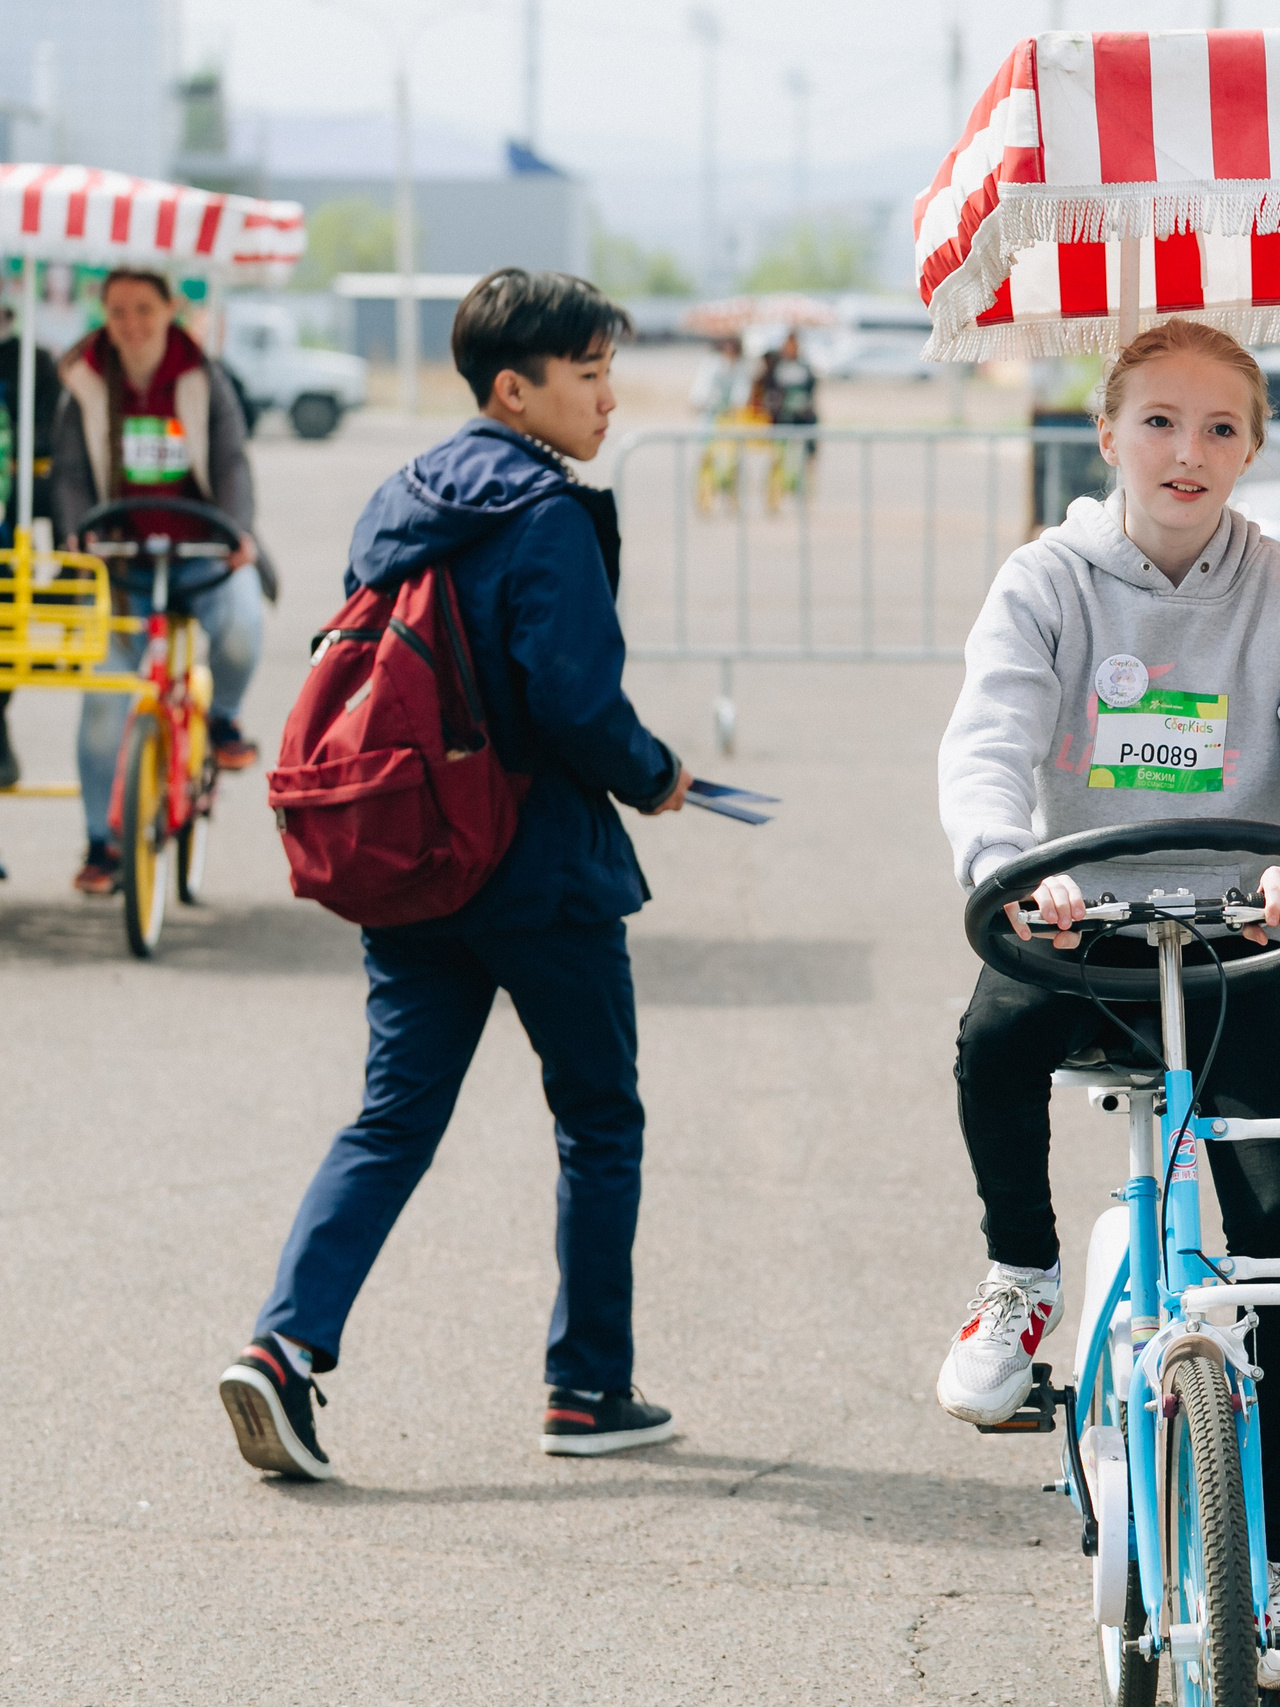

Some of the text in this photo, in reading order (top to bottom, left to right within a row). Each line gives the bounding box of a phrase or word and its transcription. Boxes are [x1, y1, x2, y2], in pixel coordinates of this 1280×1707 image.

[1164, 717, 1213, 734] СберKids
[1120, 743, 1197, 768] P-0089
[1137, 768, 1176, 782] бежим
